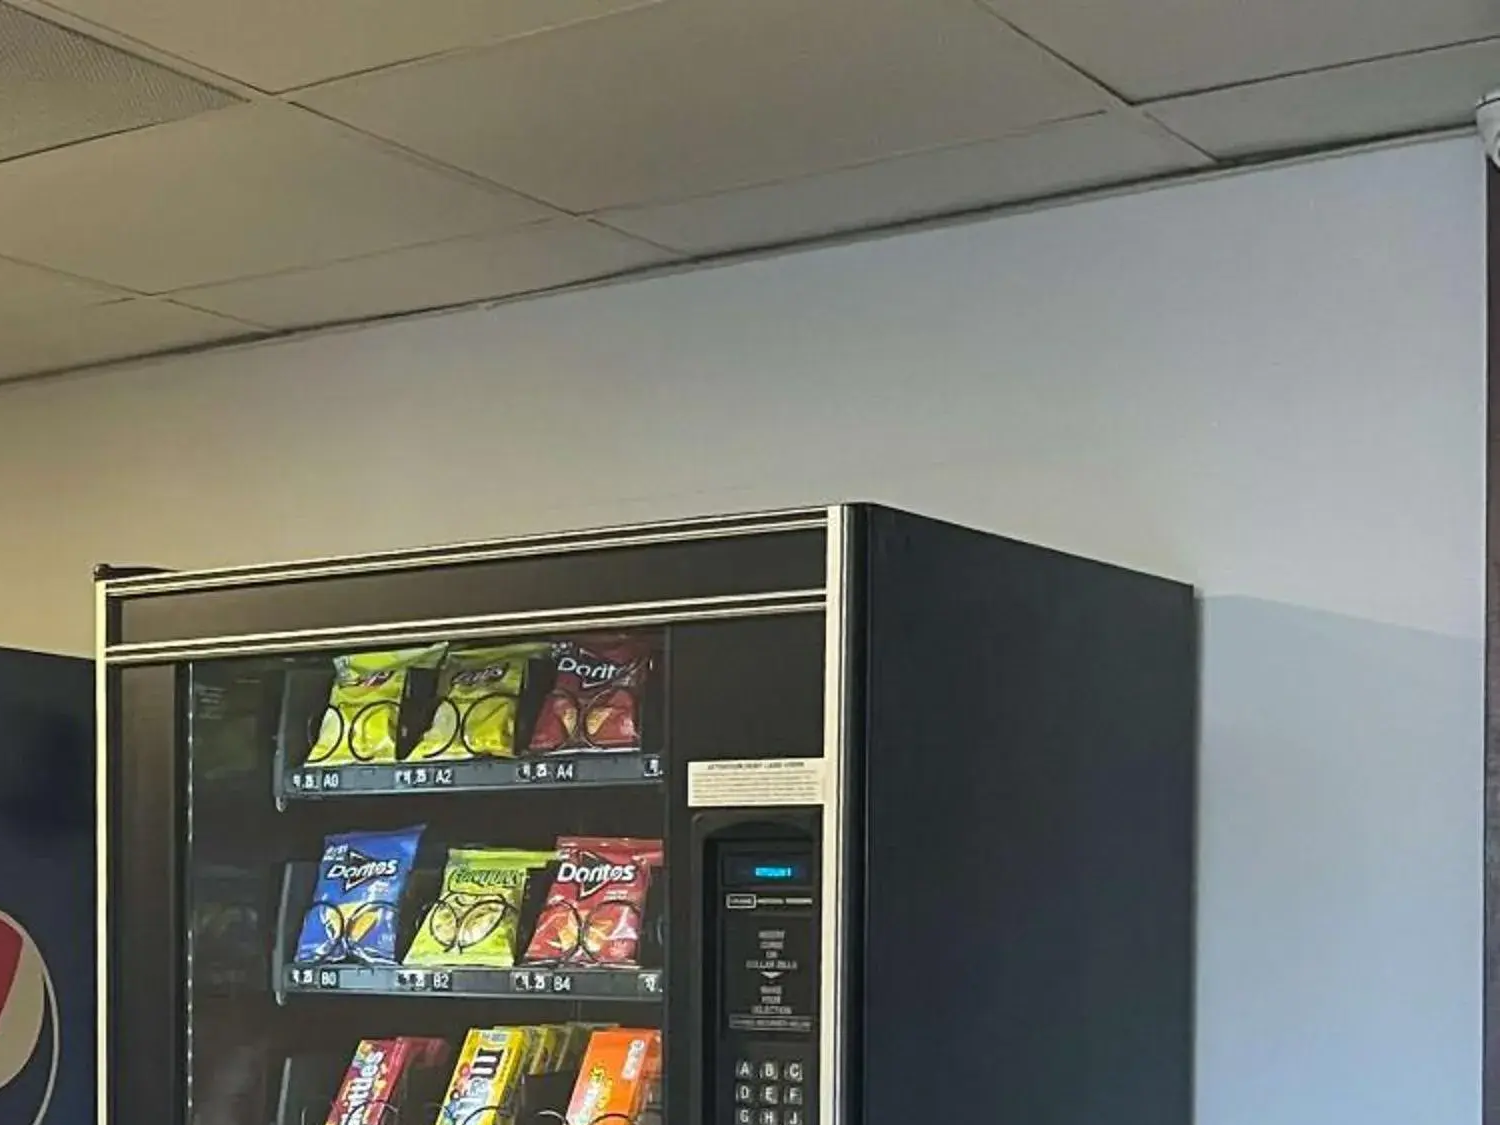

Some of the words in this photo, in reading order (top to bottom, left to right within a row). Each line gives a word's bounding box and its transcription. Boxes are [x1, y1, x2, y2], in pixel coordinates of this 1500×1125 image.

[557, 656, 632, 683] Dorit
[435, 769, 453, 783] A2
[556, 763, 573, 779] A4
[327, 859, 398, 879] Doritos
[557, 863, 636, 882] Doritos
